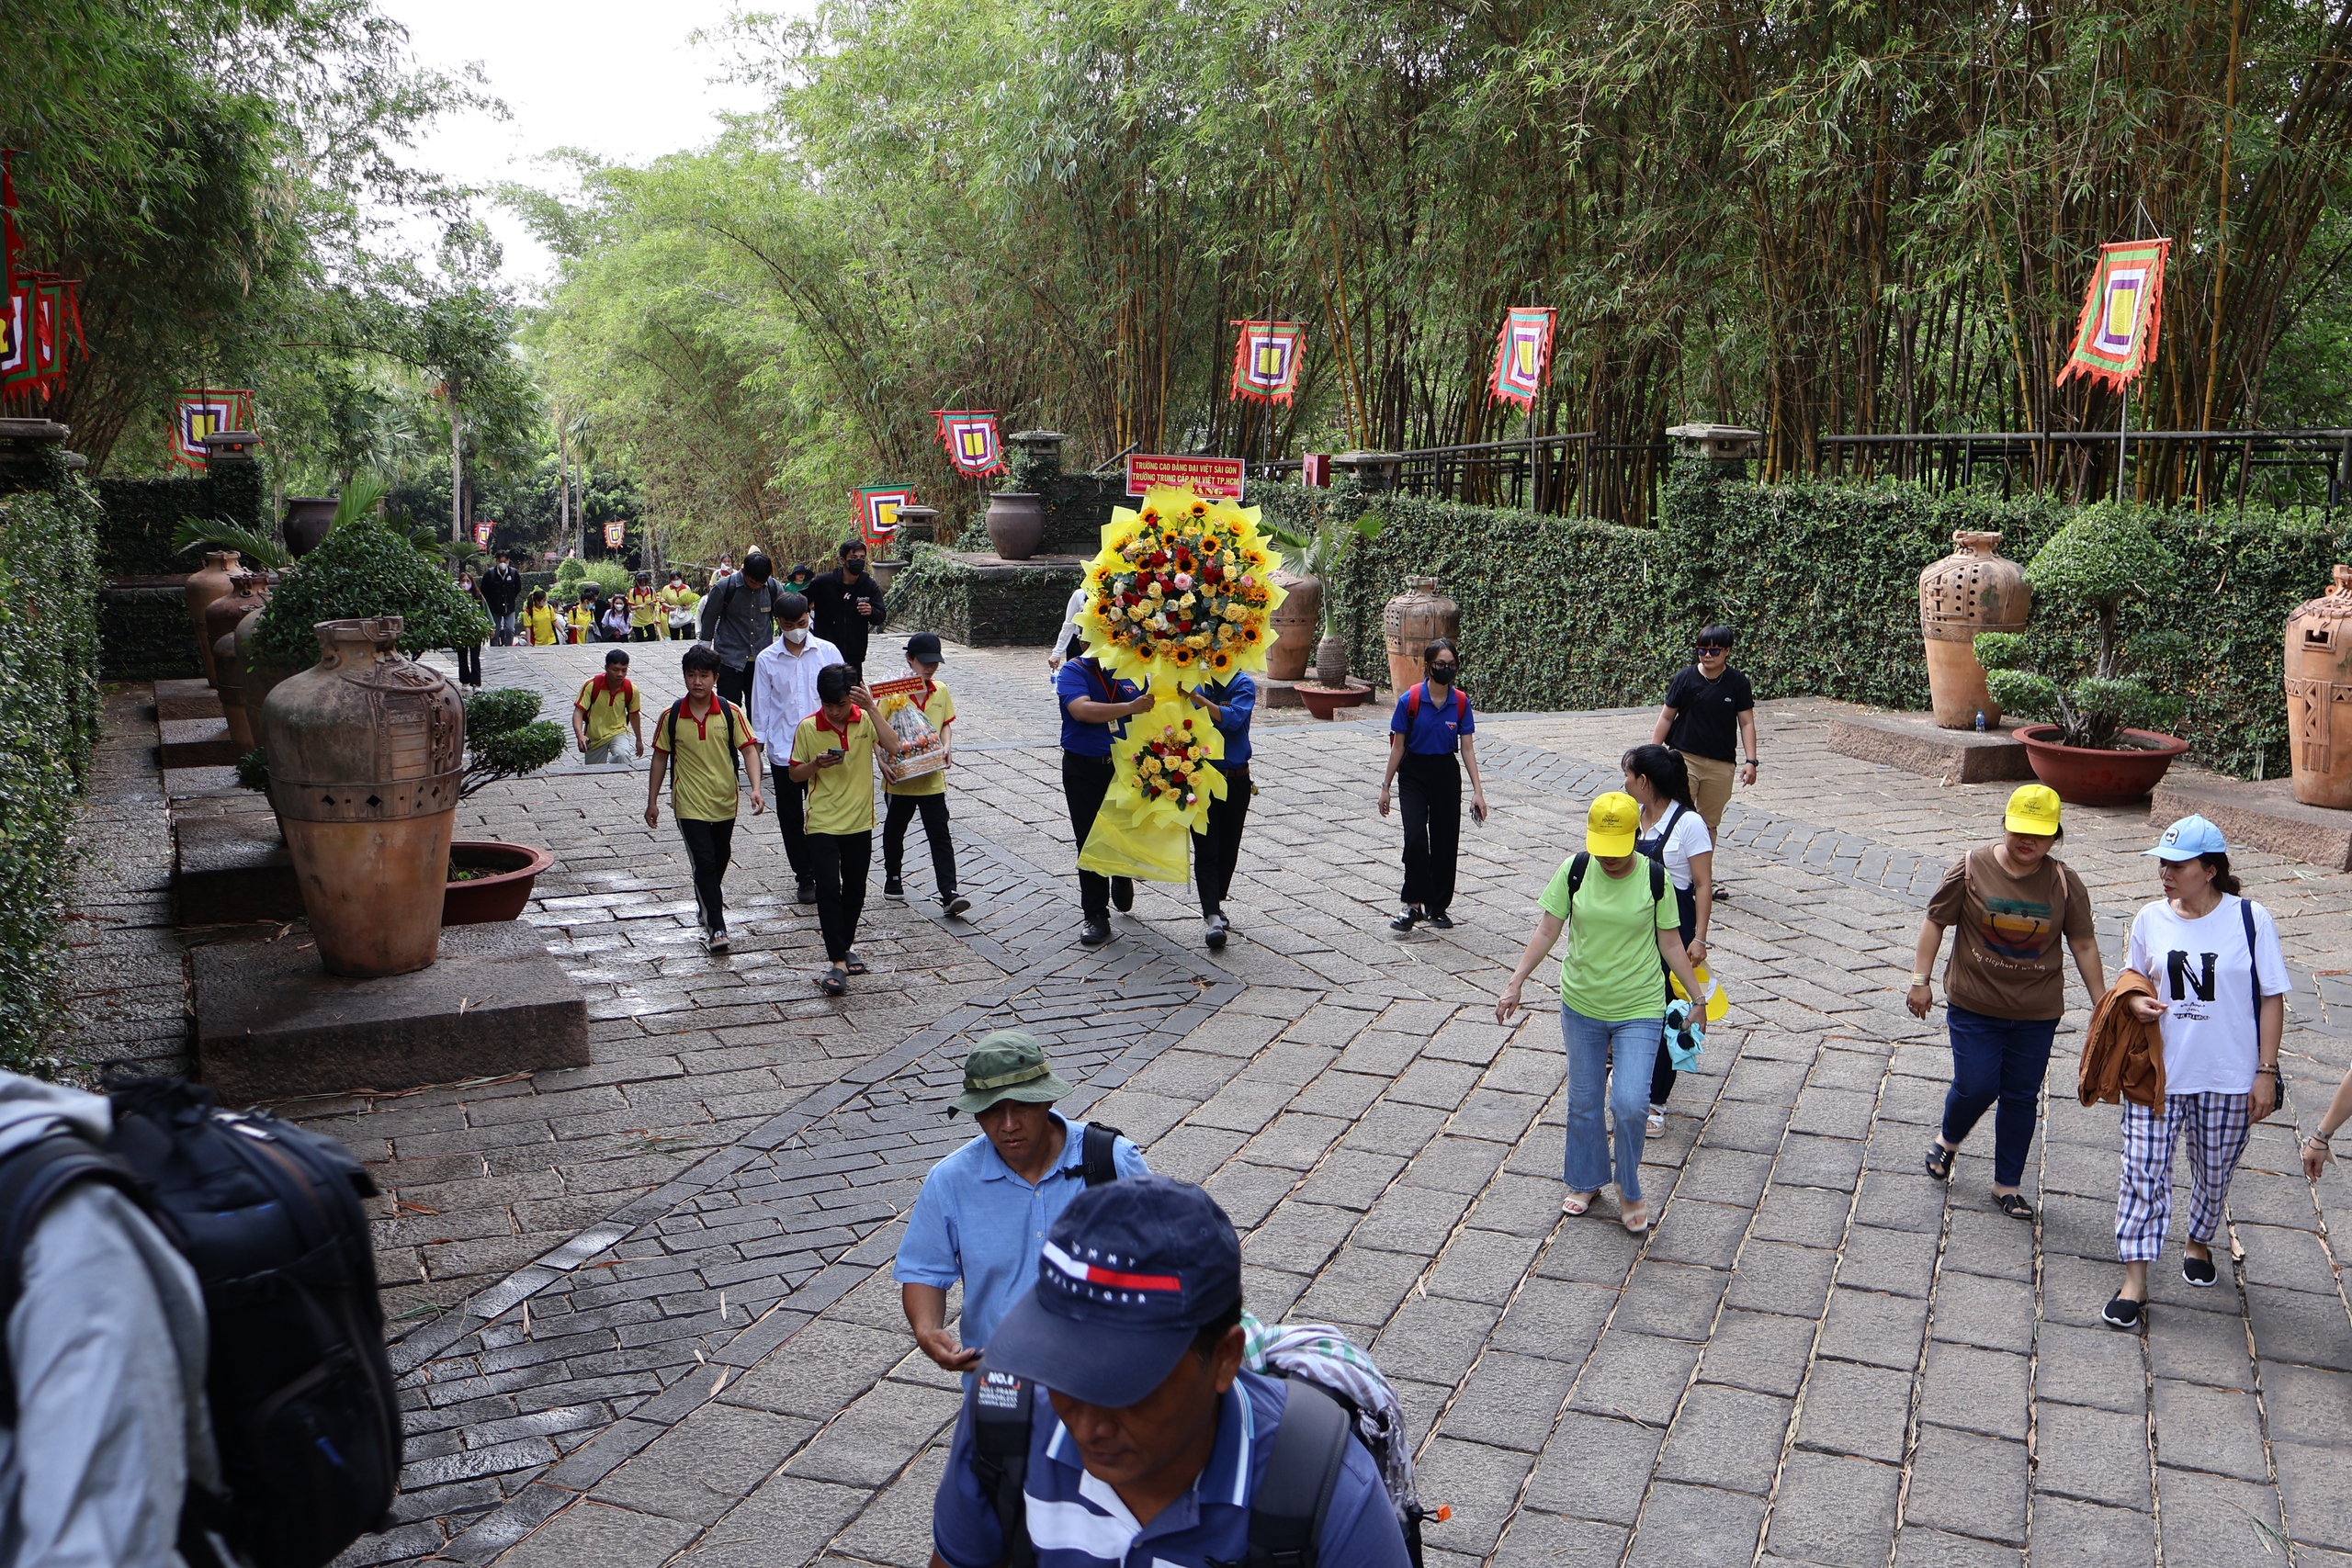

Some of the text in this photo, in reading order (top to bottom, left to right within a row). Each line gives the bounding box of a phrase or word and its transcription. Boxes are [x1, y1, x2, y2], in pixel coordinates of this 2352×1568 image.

[1135, 460, 1158, 471] TRƯỜNG
[1188, 464, 1198, 473] ĐẠI
[1199, 463, 1213, 474] VIỆT
[1214, 465, 1223, 474] SÀI
[1225, 465, 1237, 474] GÒN
[1132, 471, 1156, 481] TRƯỜNG
[1157, 474, 1176, 483] TRUNG
[1177, 472, 1189, 483] CẤP
[1201, 474, 1215, 485] VIỆT
[1216, 477, 1239, 486] TP.HCM
[1984, 957, 2018, 970] elephant
[2167, 949, 2218, 1002] N
[1071, 1240, 1136, 1268] OMMY
[1046, 1267, 1147, 1304] HILFIGER
